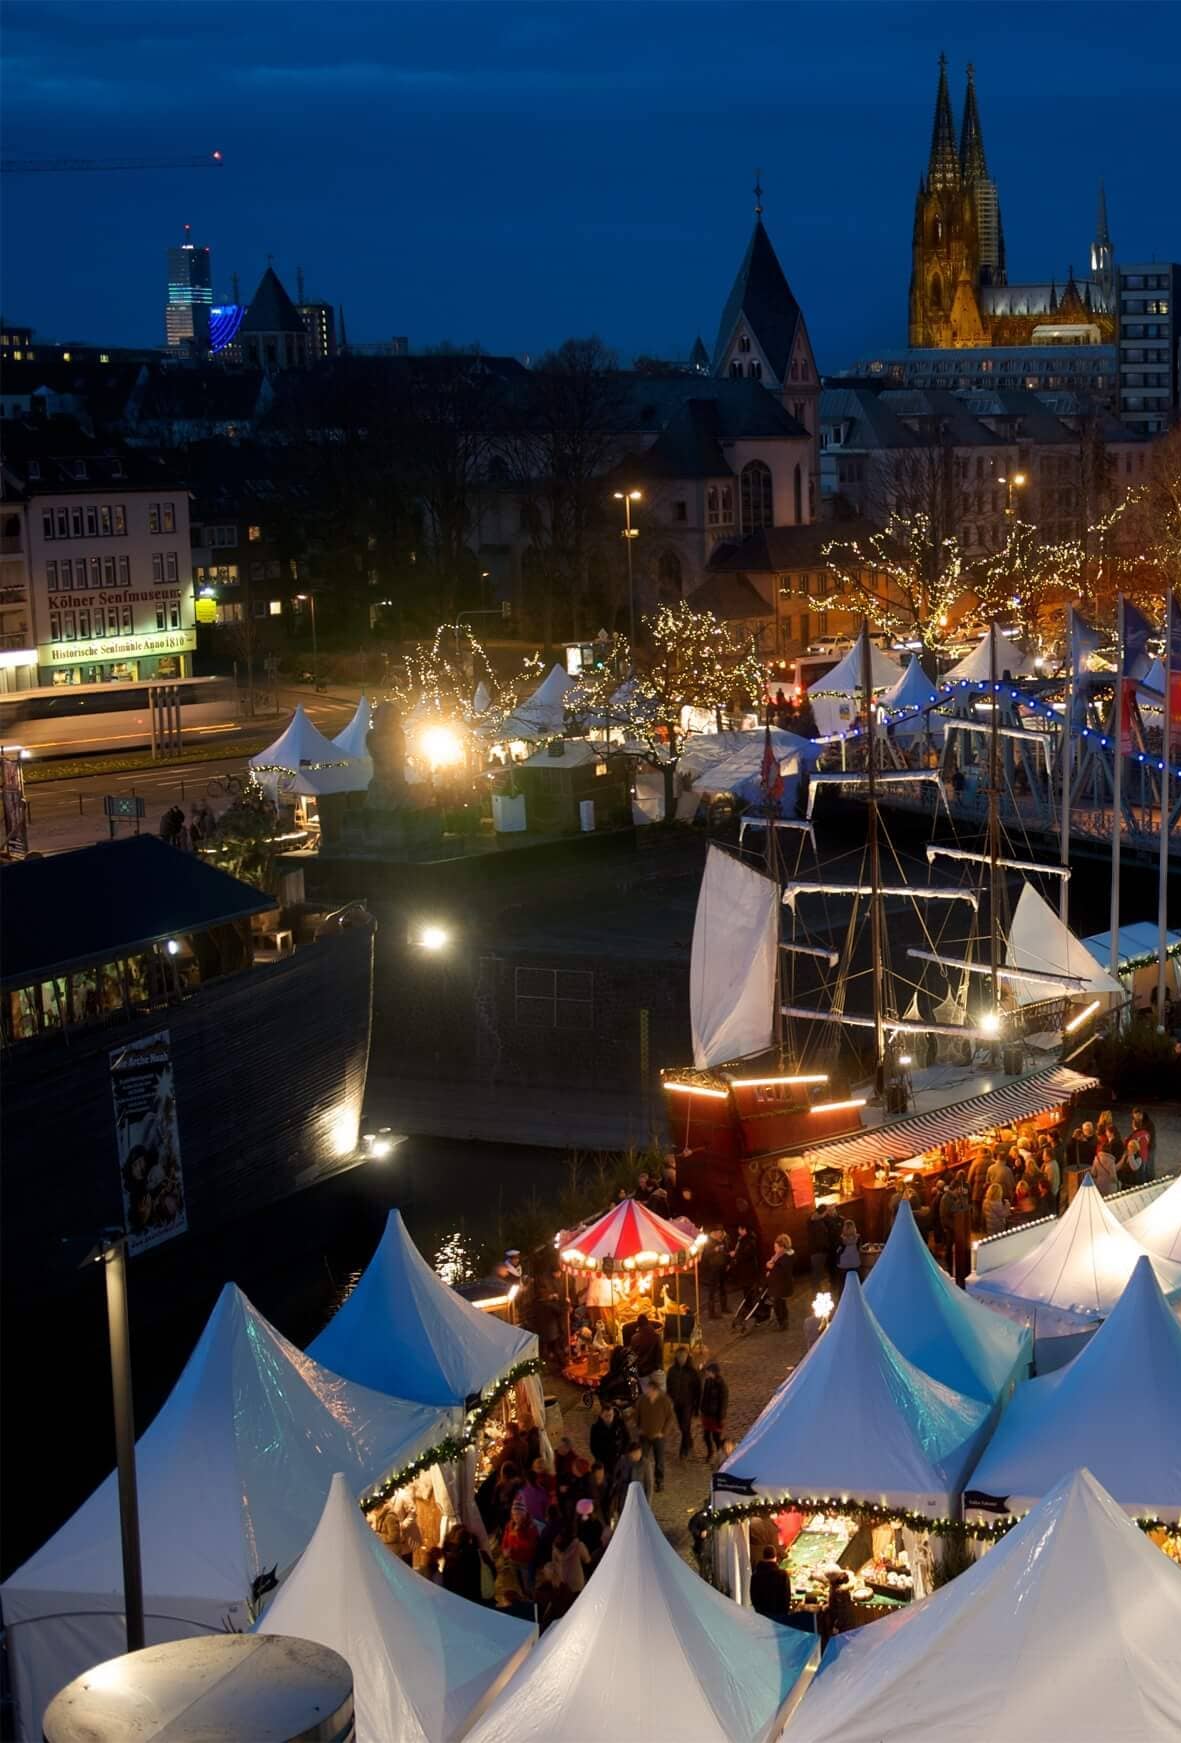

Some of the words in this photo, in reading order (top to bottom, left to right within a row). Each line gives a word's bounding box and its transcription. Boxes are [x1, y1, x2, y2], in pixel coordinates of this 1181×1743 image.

[48, 594, 95, 610] Kölner
[99, 589, 182, 605] Senfmuseum
[52, 645, 98, 660] Historische
[101, 642, 142, 655] Senfmühle
[144, 640, 165, 649] Anno
